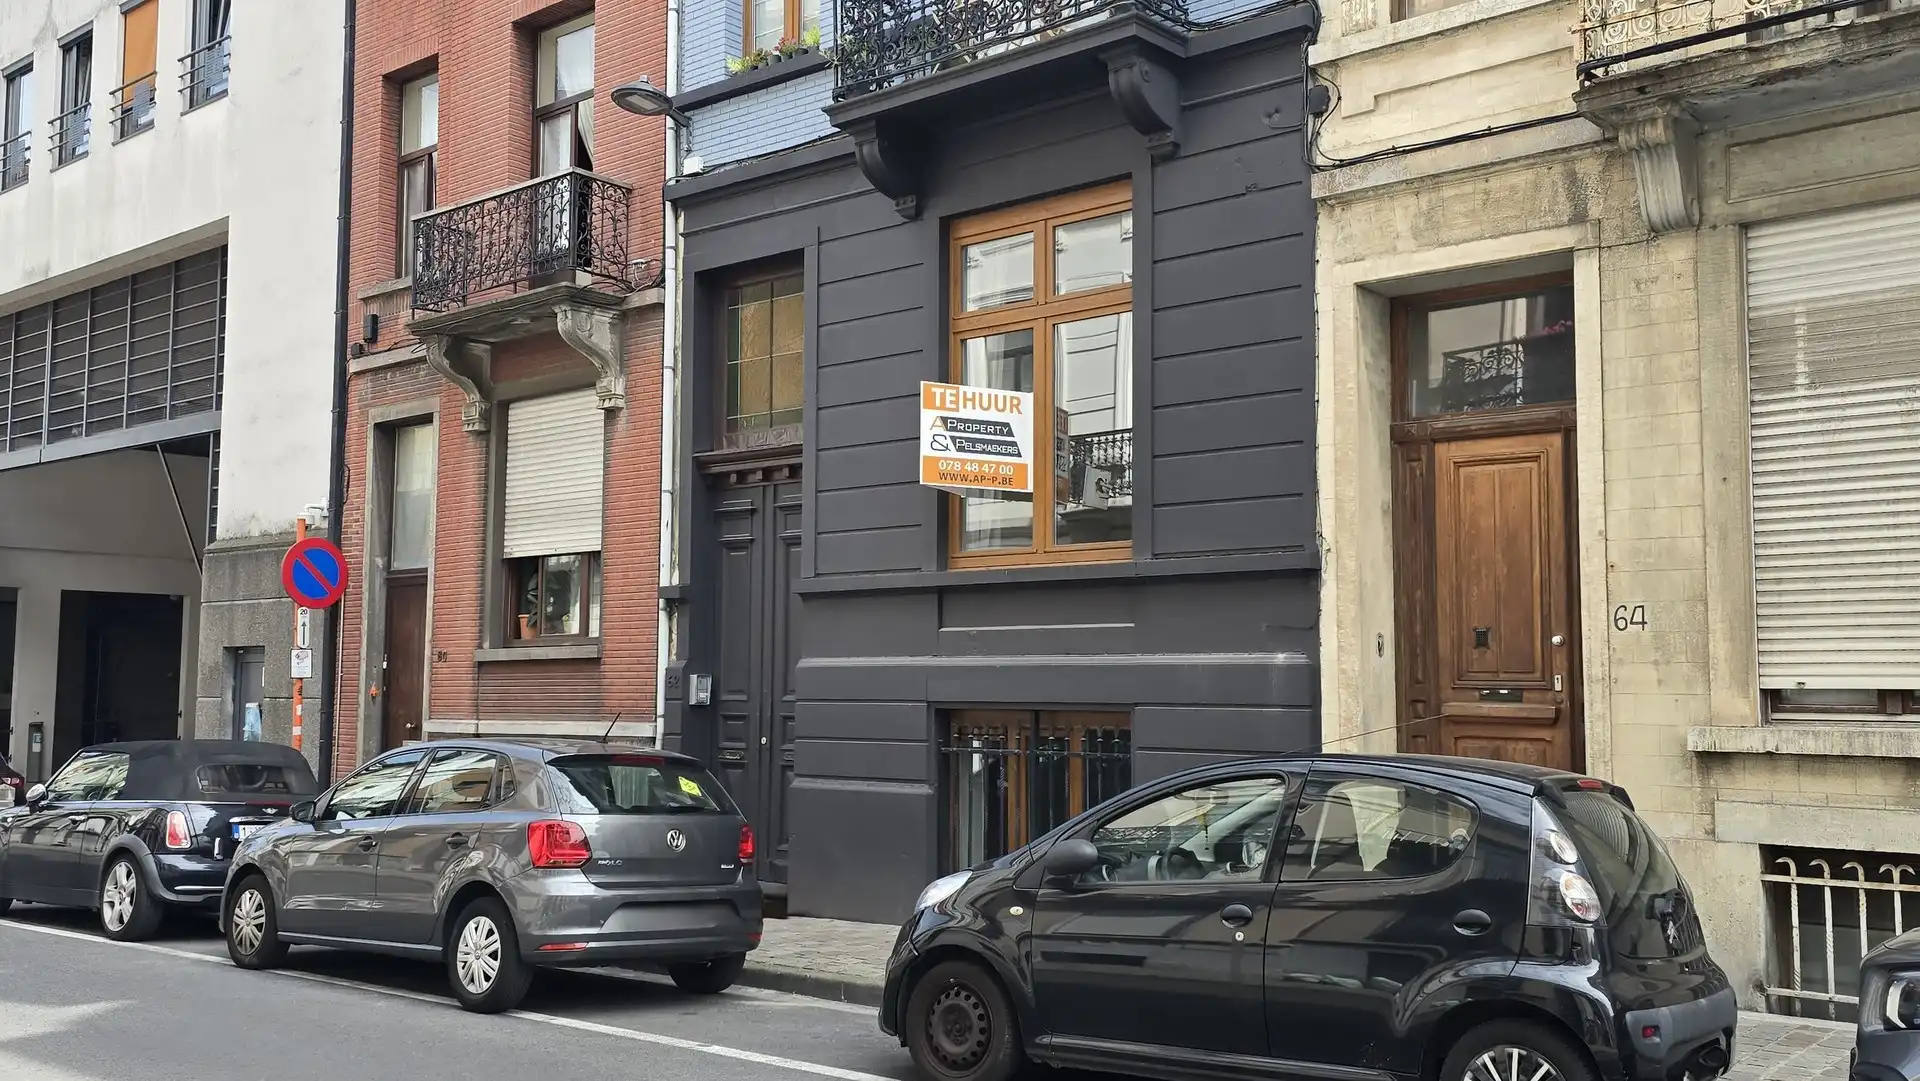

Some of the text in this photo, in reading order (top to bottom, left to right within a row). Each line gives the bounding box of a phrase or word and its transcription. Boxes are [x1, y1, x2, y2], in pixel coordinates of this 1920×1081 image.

[931, 388, 1023, 415] TE HUUR
[930, 416, 1009, 435] A PROPERTY
[930, 433, 951, 452] &
[938, 460, 1014, 475] 078 48 47 00
[938, 472, 1014, 486] WWW.AP-P.BE
[1614, 605, 1648, 631] 64
